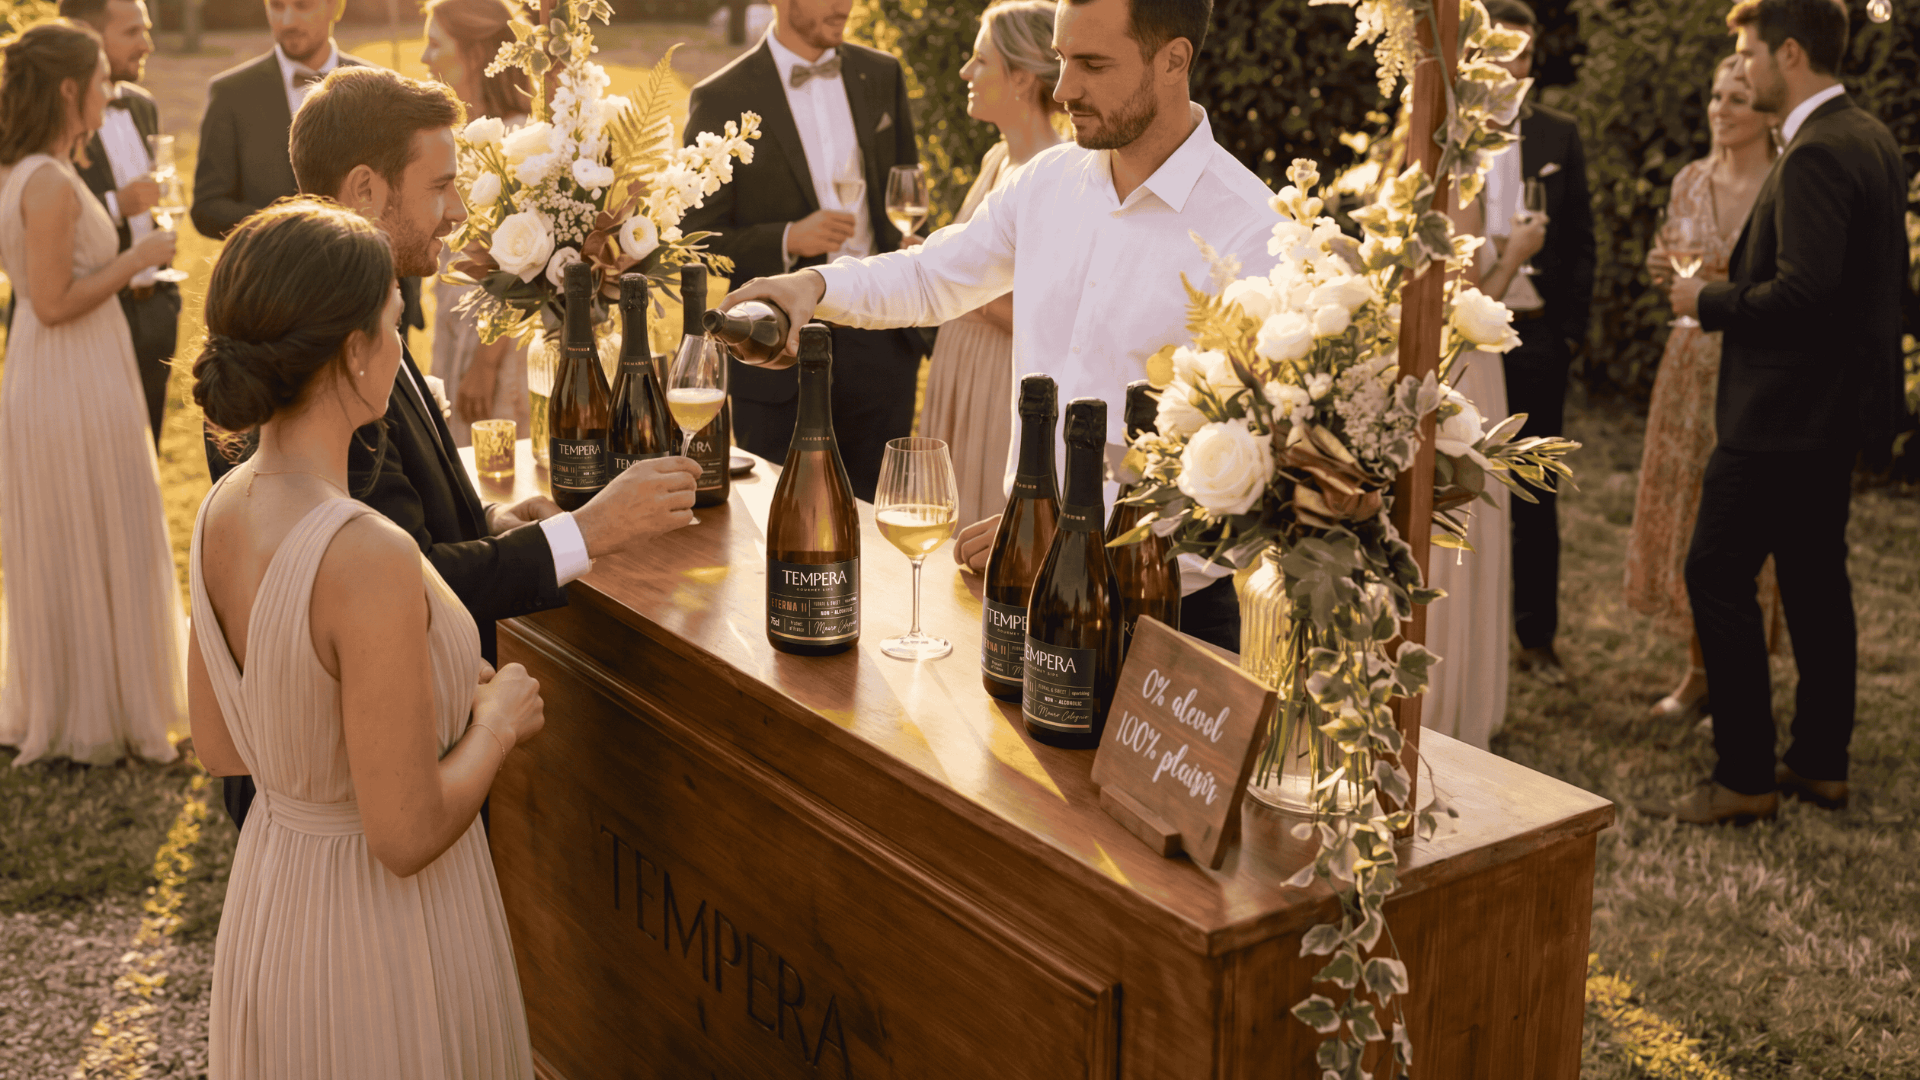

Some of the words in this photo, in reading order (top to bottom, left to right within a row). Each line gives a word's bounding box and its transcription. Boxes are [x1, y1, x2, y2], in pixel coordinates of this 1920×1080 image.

[558, 443, 602, 456] TEMPERA
[781, 569, 848, 587] TEMPERA
[771, 597, 798, 612] ETERNA
[801, 602, 807, 613] II
[1000, 645, 1006, 655] II
[1025, 641, 1077, 673] EMPERA
[1142, 668, 1171, 706] 0%
[1115, 710, 1161, 760] 100%
[600, 824, 855, 1080] TEMPERA
